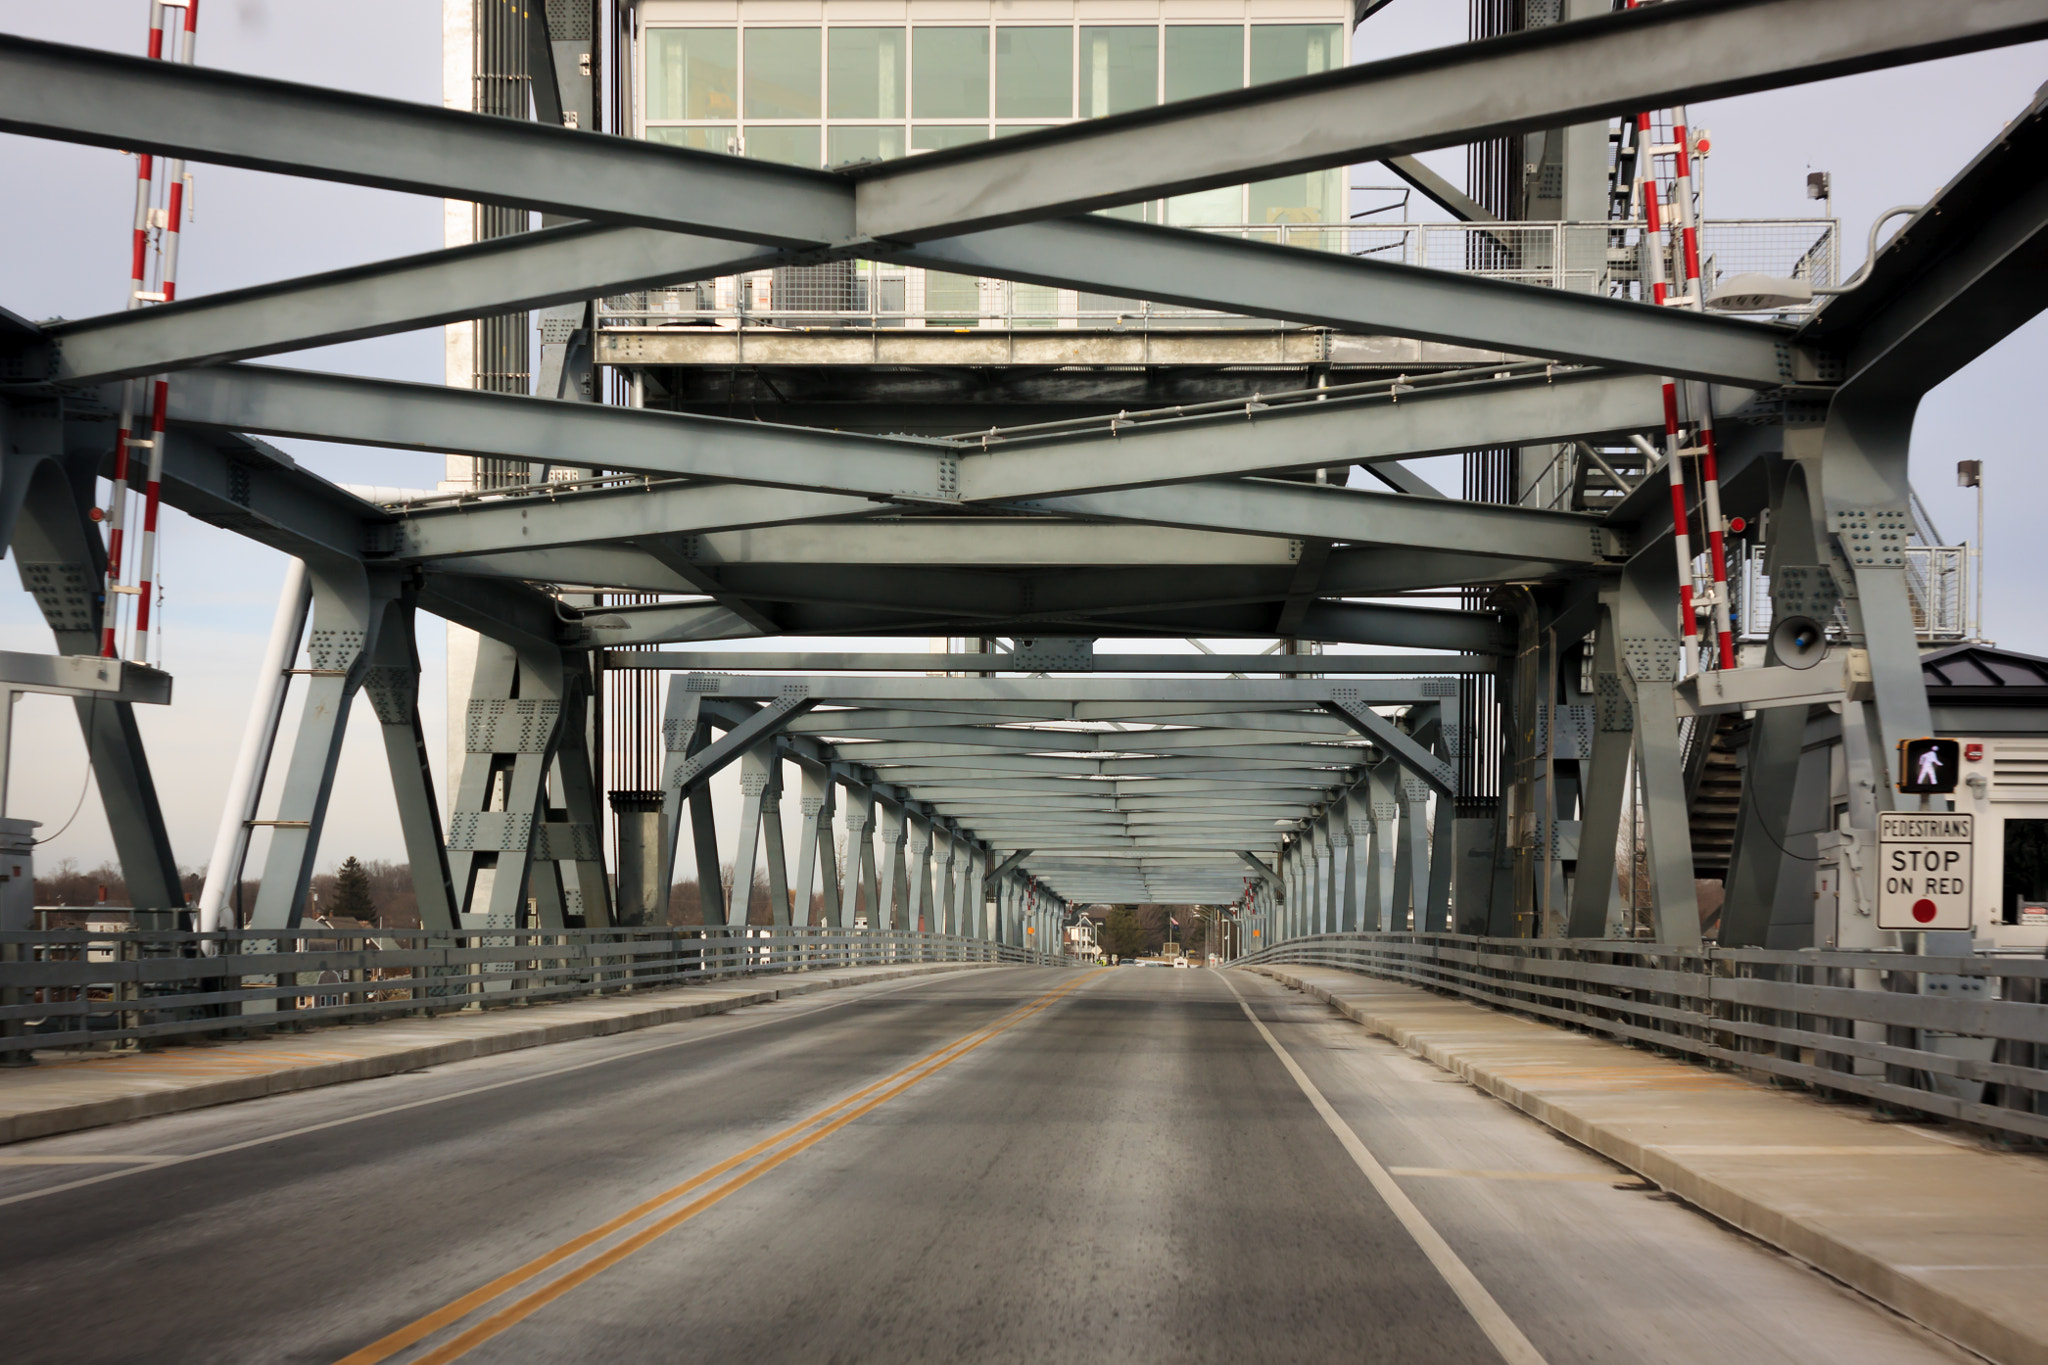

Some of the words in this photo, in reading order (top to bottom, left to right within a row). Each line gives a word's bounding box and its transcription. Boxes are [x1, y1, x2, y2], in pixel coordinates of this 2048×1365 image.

[1883, 820, 1969, 837] PEDESTRIANS
[1891, 850, 1961, 872] STOP
[1886, 877, 1913, 894] ON
[1925, 878, 1965, 895] RED
